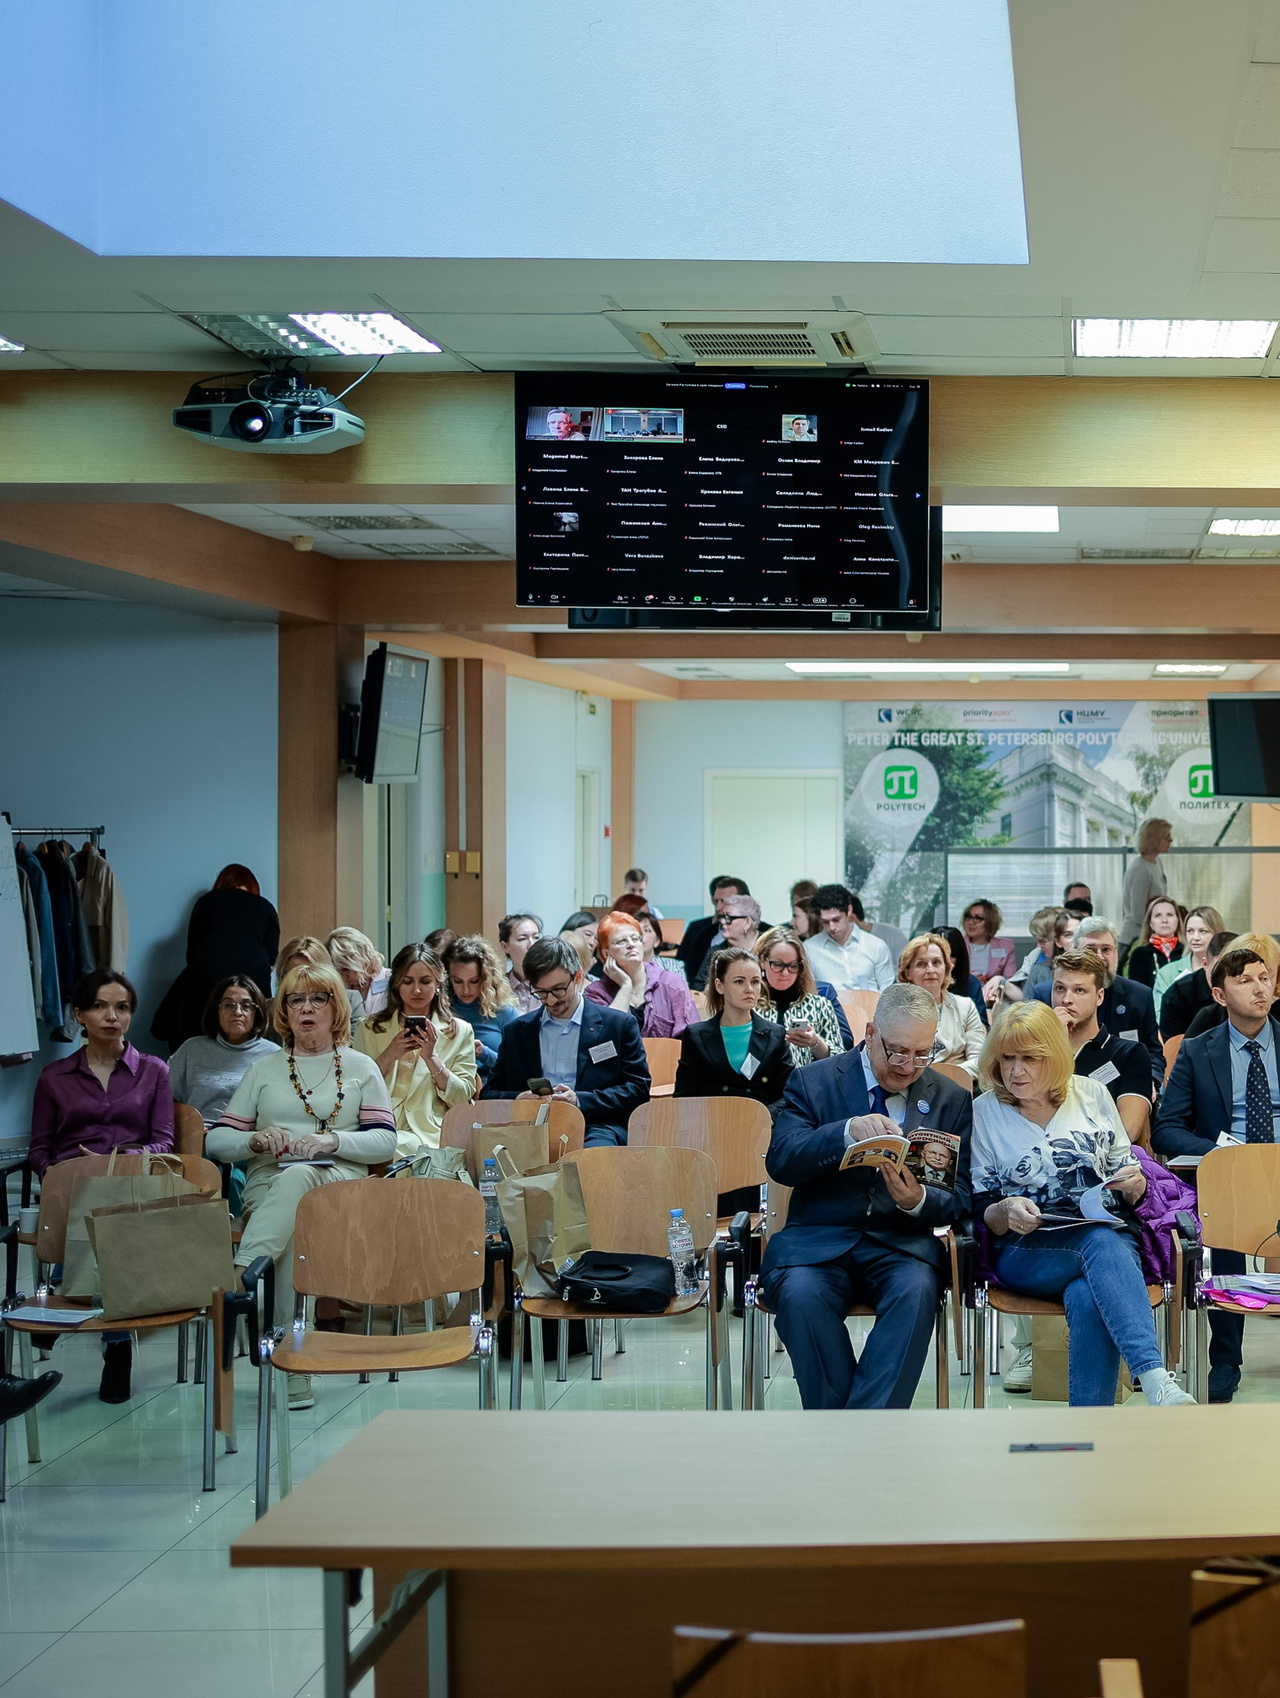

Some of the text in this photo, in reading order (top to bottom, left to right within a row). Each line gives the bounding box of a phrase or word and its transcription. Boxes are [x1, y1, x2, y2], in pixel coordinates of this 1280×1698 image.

[847, 732, 890, 746] PETER
[892, 732, 919, 746] THE
[921, 732, 964, 746] GREAT
[966, 732, 985, 746] ST.
[988, 732, 1074, 746] PETERSBURG
[876, 803, 926, 811] POLYTECH
[1179, 801, 1230, 810] ПОЛИТЕХ
